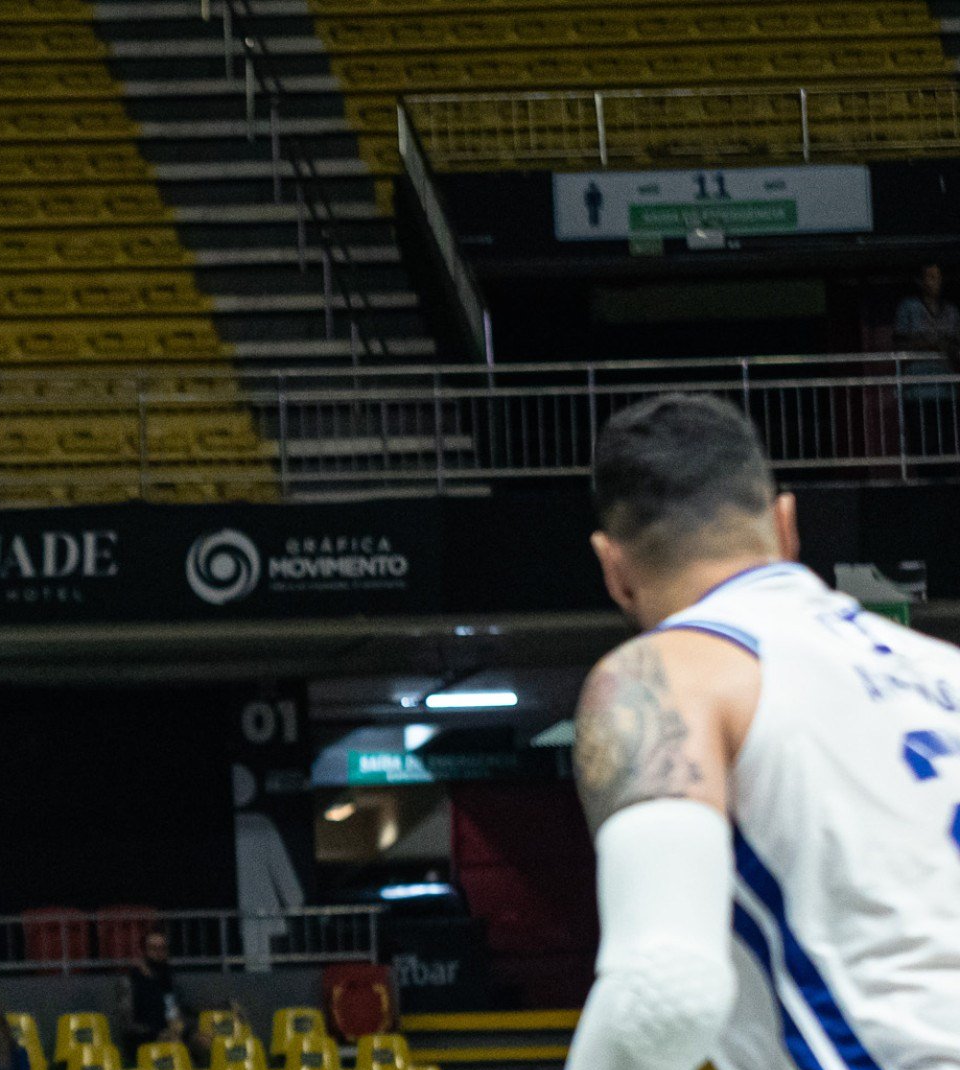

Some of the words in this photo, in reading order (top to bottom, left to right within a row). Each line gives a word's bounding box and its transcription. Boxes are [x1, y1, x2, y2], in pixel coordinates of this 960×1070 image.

[695, 170, 731, 200] 11
[268, 554, 409, 579] MOVIMENTO
[241, 701, 298, 743] 01
